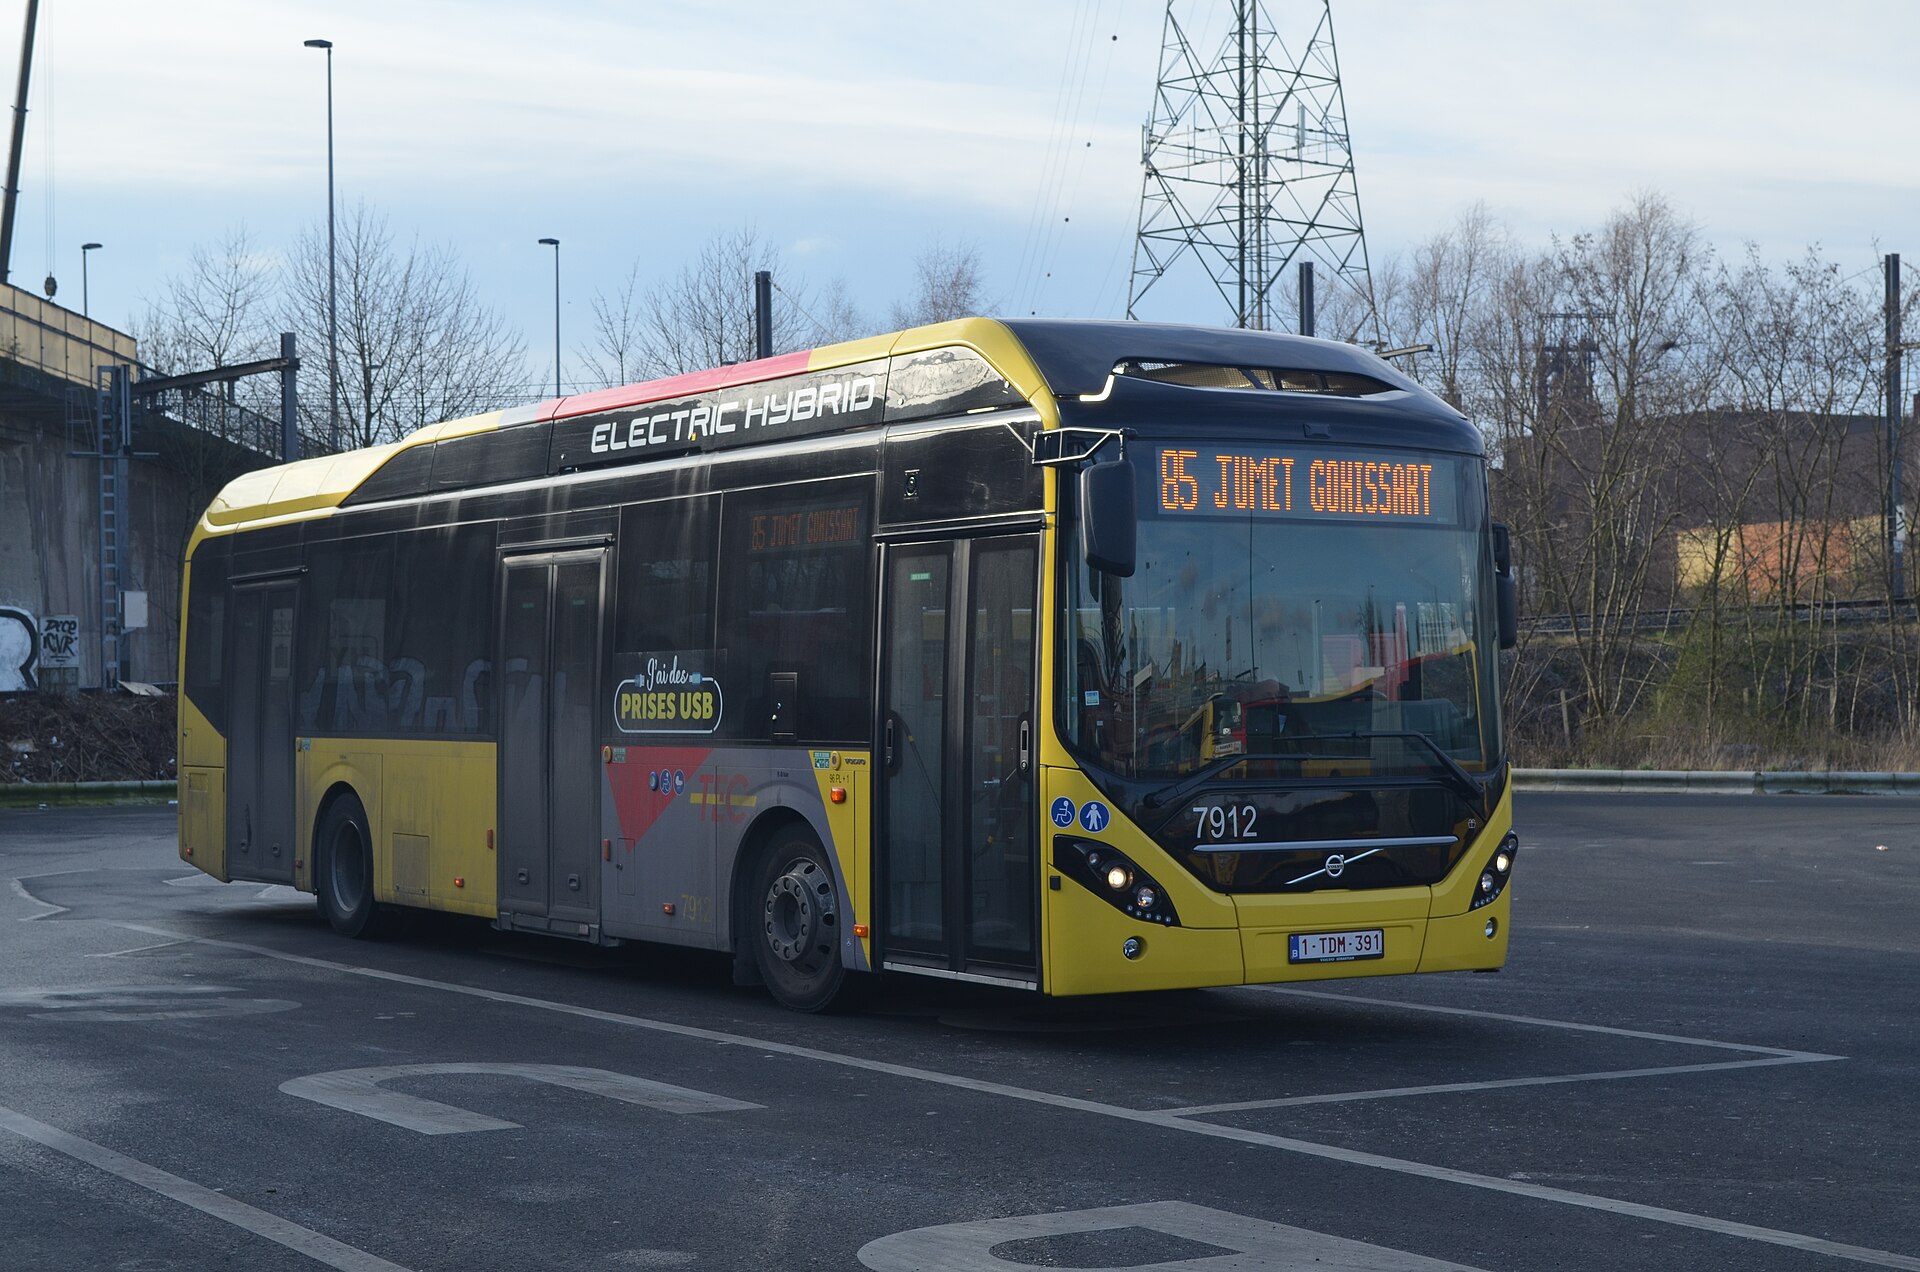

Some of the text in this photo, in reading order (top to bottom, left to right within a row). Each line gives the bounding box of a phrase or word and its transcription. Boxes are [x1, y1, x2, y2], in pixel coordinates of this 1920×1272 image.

[591, 378, 875, 453] ELECTRIC HYBRID
[1161, 449, 1432, 515] 85 JUMET GOHISSART
[751, 514, 767, 551] 85
[770, 512, 803, 547] JUMET
[646, 655, 689, 691] J'ai des
[621, 691, 714, 720] PRISES USB
[699, 773, 749, 825] TEC
[1193, 806, 1257, 838] 7912
[1292, 933, 1379, 958] B 1-TDM-391
